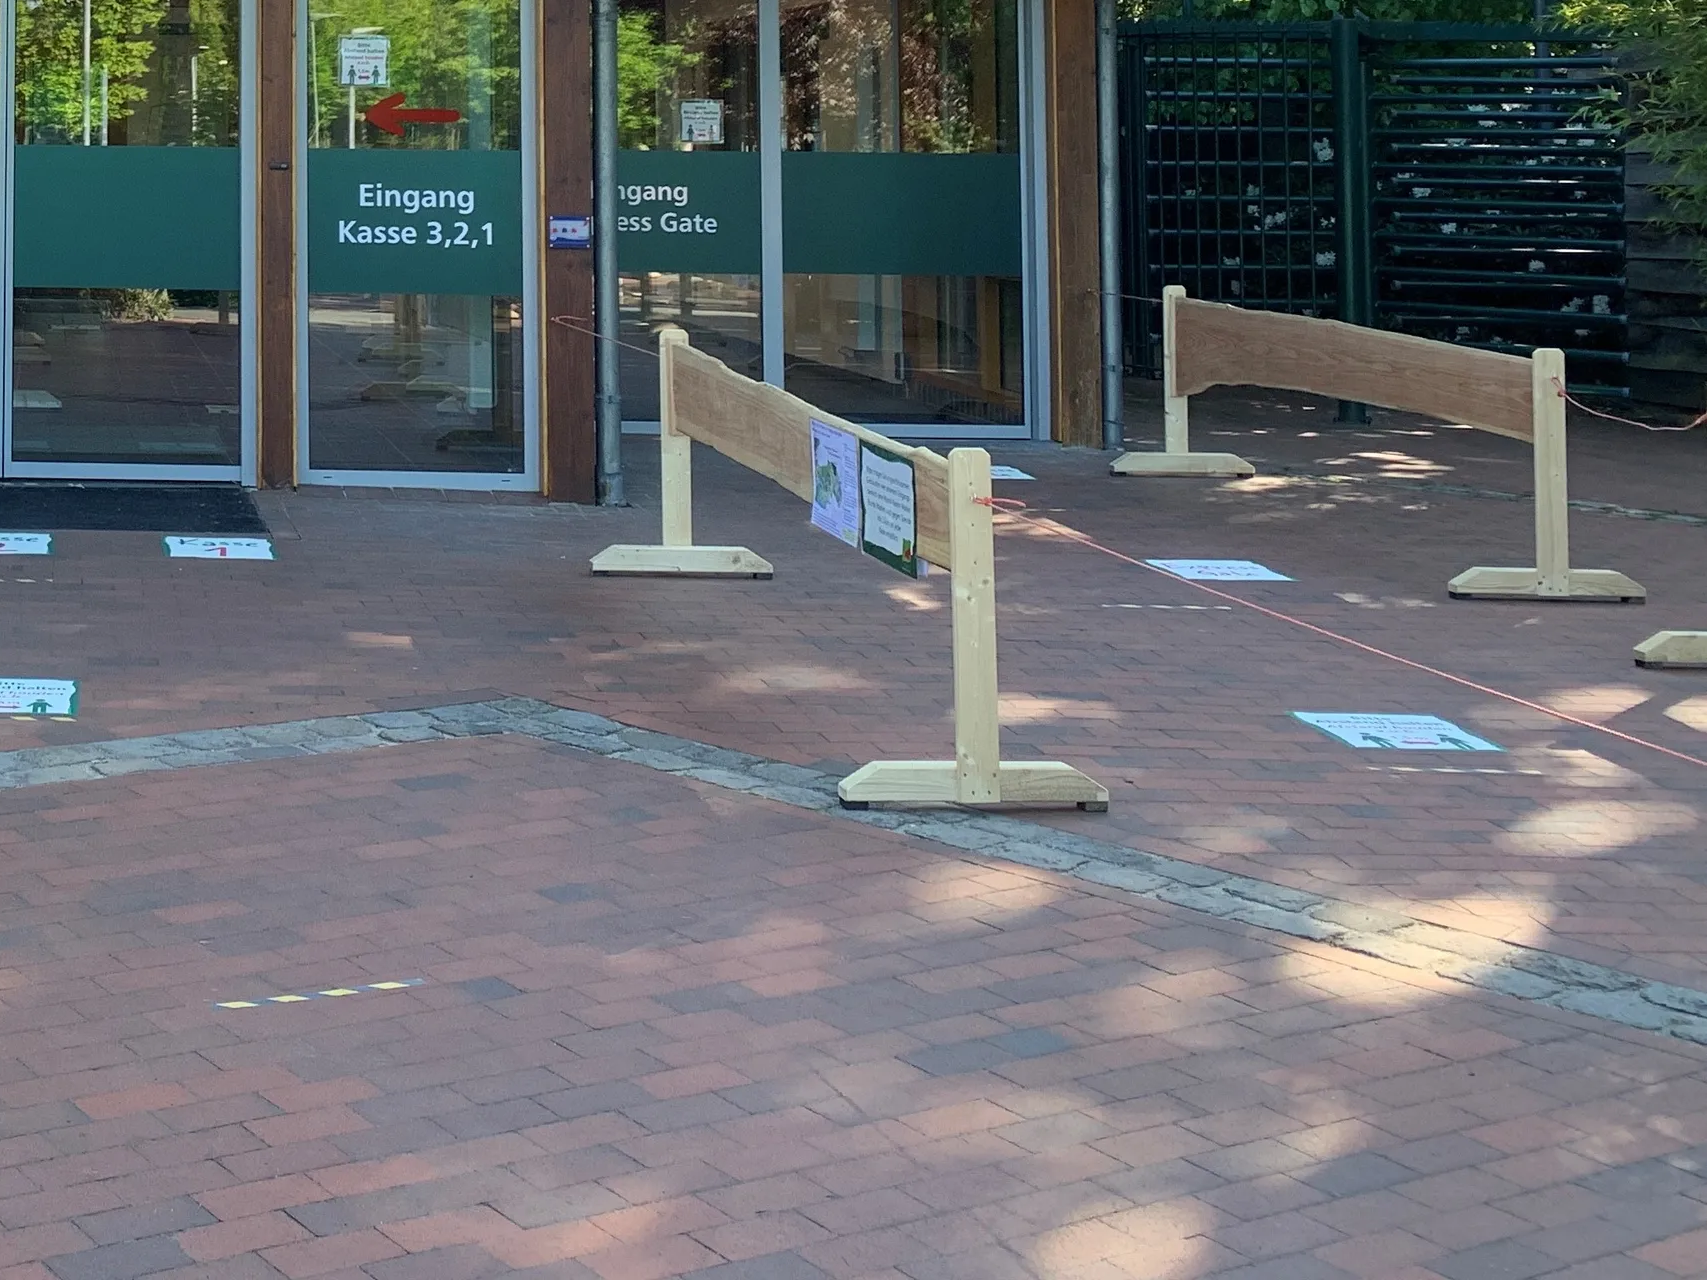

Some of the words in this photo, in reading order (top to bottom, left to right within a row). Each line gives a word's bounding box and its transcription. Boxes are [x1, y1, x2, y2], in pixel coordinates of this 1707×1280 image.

[358, 182, 475, 215] Eingang
[591, 181, 689, 207] ngang
[338, 220, 418, 244] Kasse
[426, 221, 493, 249] 3,2,1
[660, 212, 718, 234] Gate
[178, 538, 259, 548] Kasse
[204, 546, 227, 557] 1
